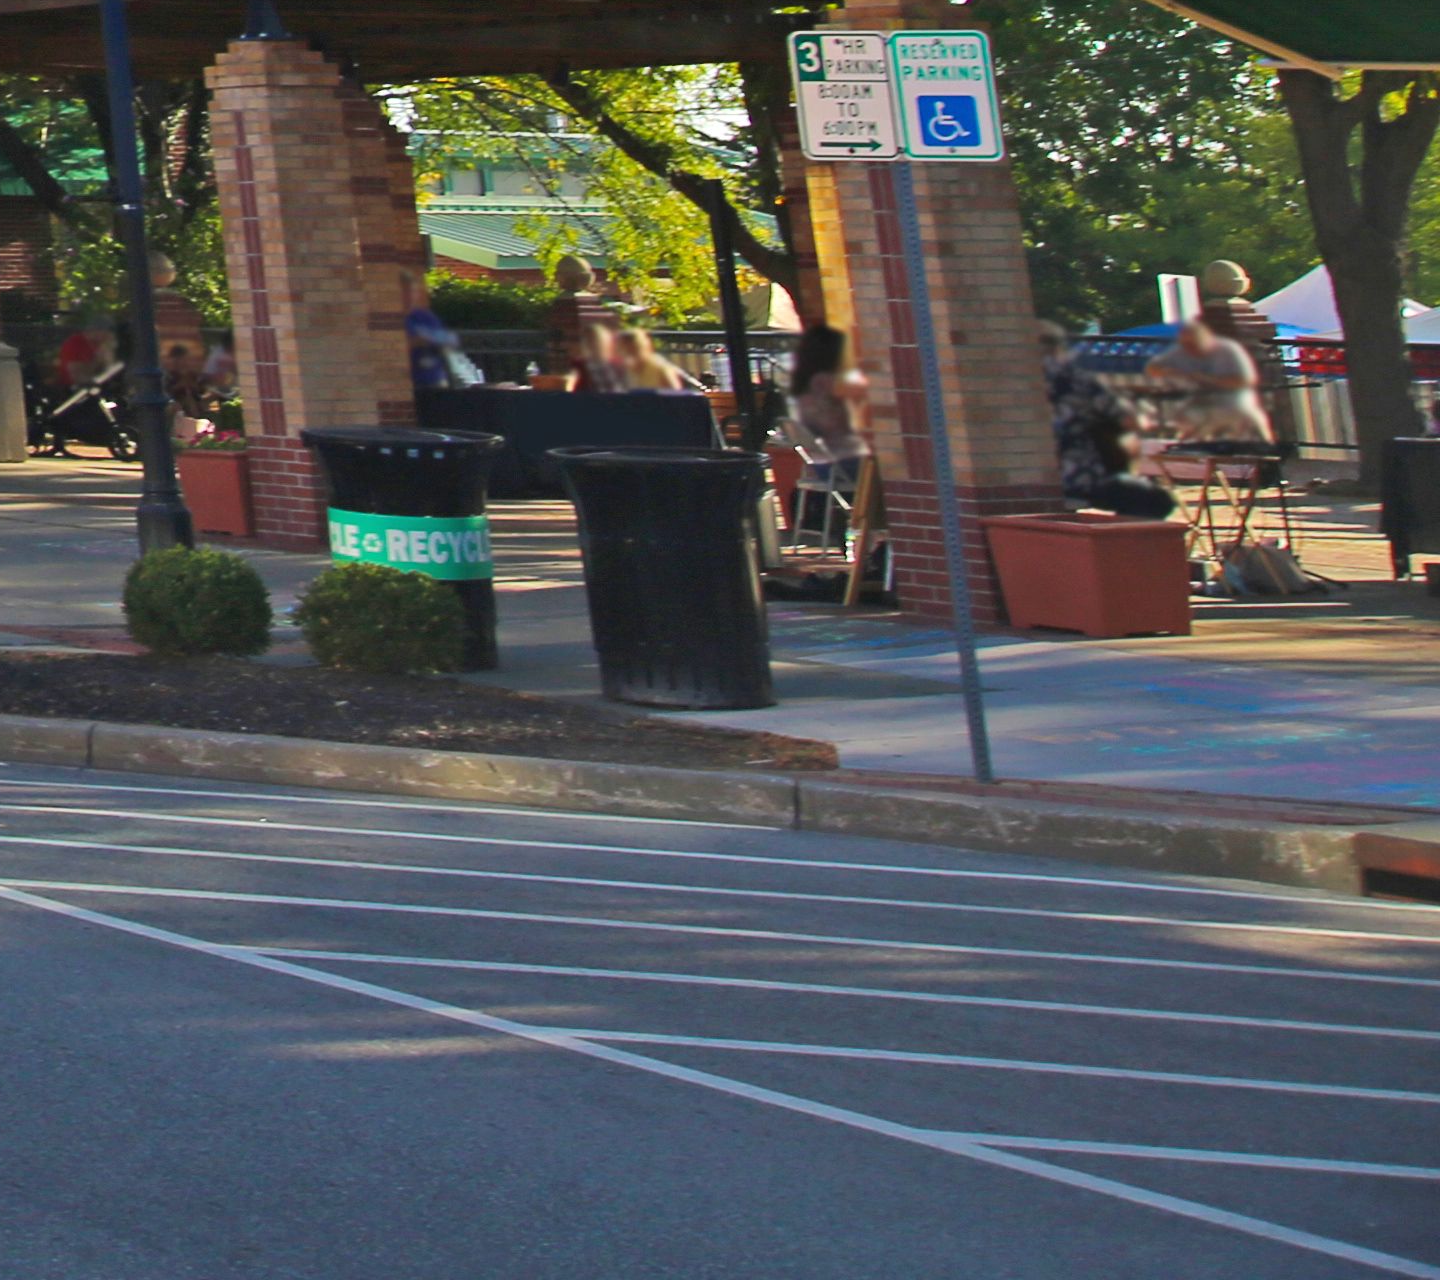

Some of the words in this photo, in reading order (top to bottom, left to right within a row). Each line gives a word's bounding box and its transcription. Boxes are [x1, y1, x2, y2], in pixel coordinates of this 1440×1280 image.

[841, 39, 867, 55] HR
[900, 43, 978, 59] RESERVED
[798, 42, 820, 72] 3
[825, 60, 885, 74] PARKING
[903, 66, 982, 80] PARKING
[836, 102, 860, 118] TO
[386, 529, 491, 563] RECYCL
